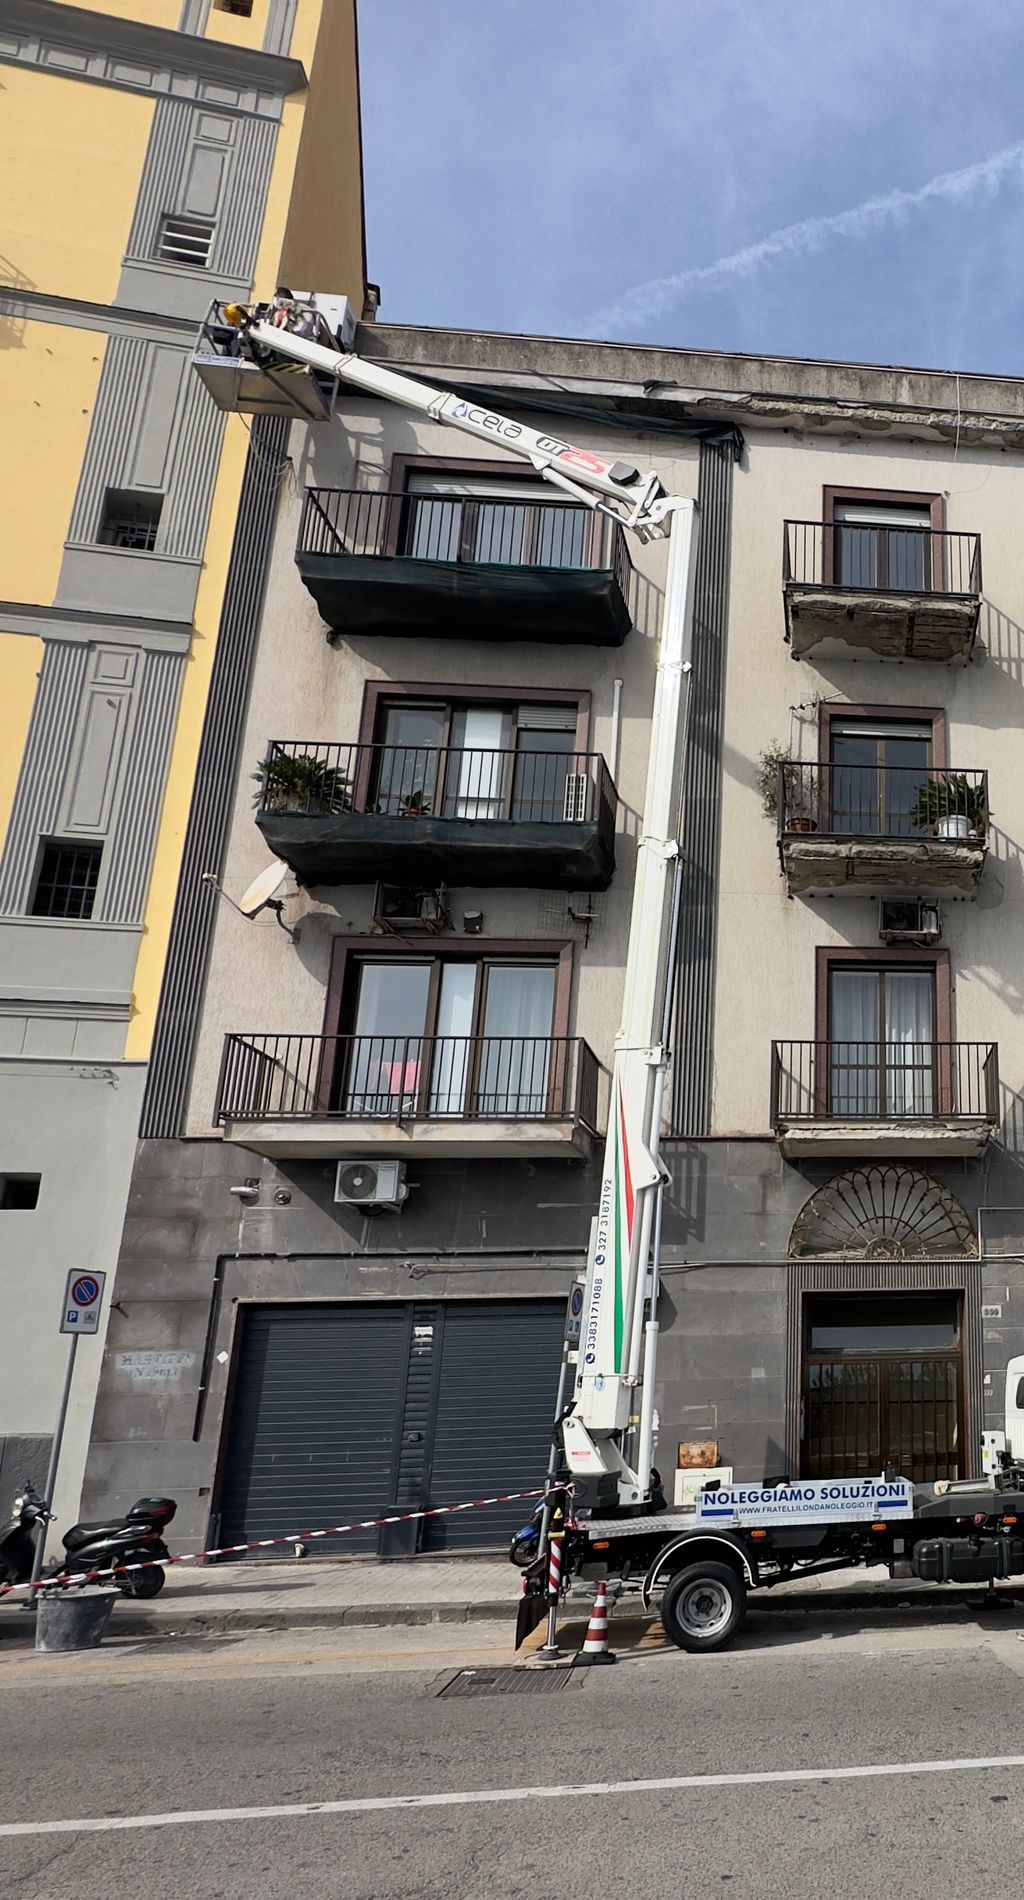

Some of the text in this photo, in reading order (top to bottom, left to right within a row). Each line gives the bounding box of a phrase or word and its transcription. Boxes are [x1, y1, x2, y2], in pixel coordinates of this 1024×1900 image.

[468, 409, 522, 438] cela
[598, 1178, 612, 1251] 327 3187192
[69, 1312, 77, 1321] P
[587, 1278, 603, 1349] 3383171088
[704, 1484, 905, 1506] NOLEGGIAMO SOLUZIONI
[739, 1501, 873, 1515] WWW.FRATELLILONDANOLEGGIO.IT
